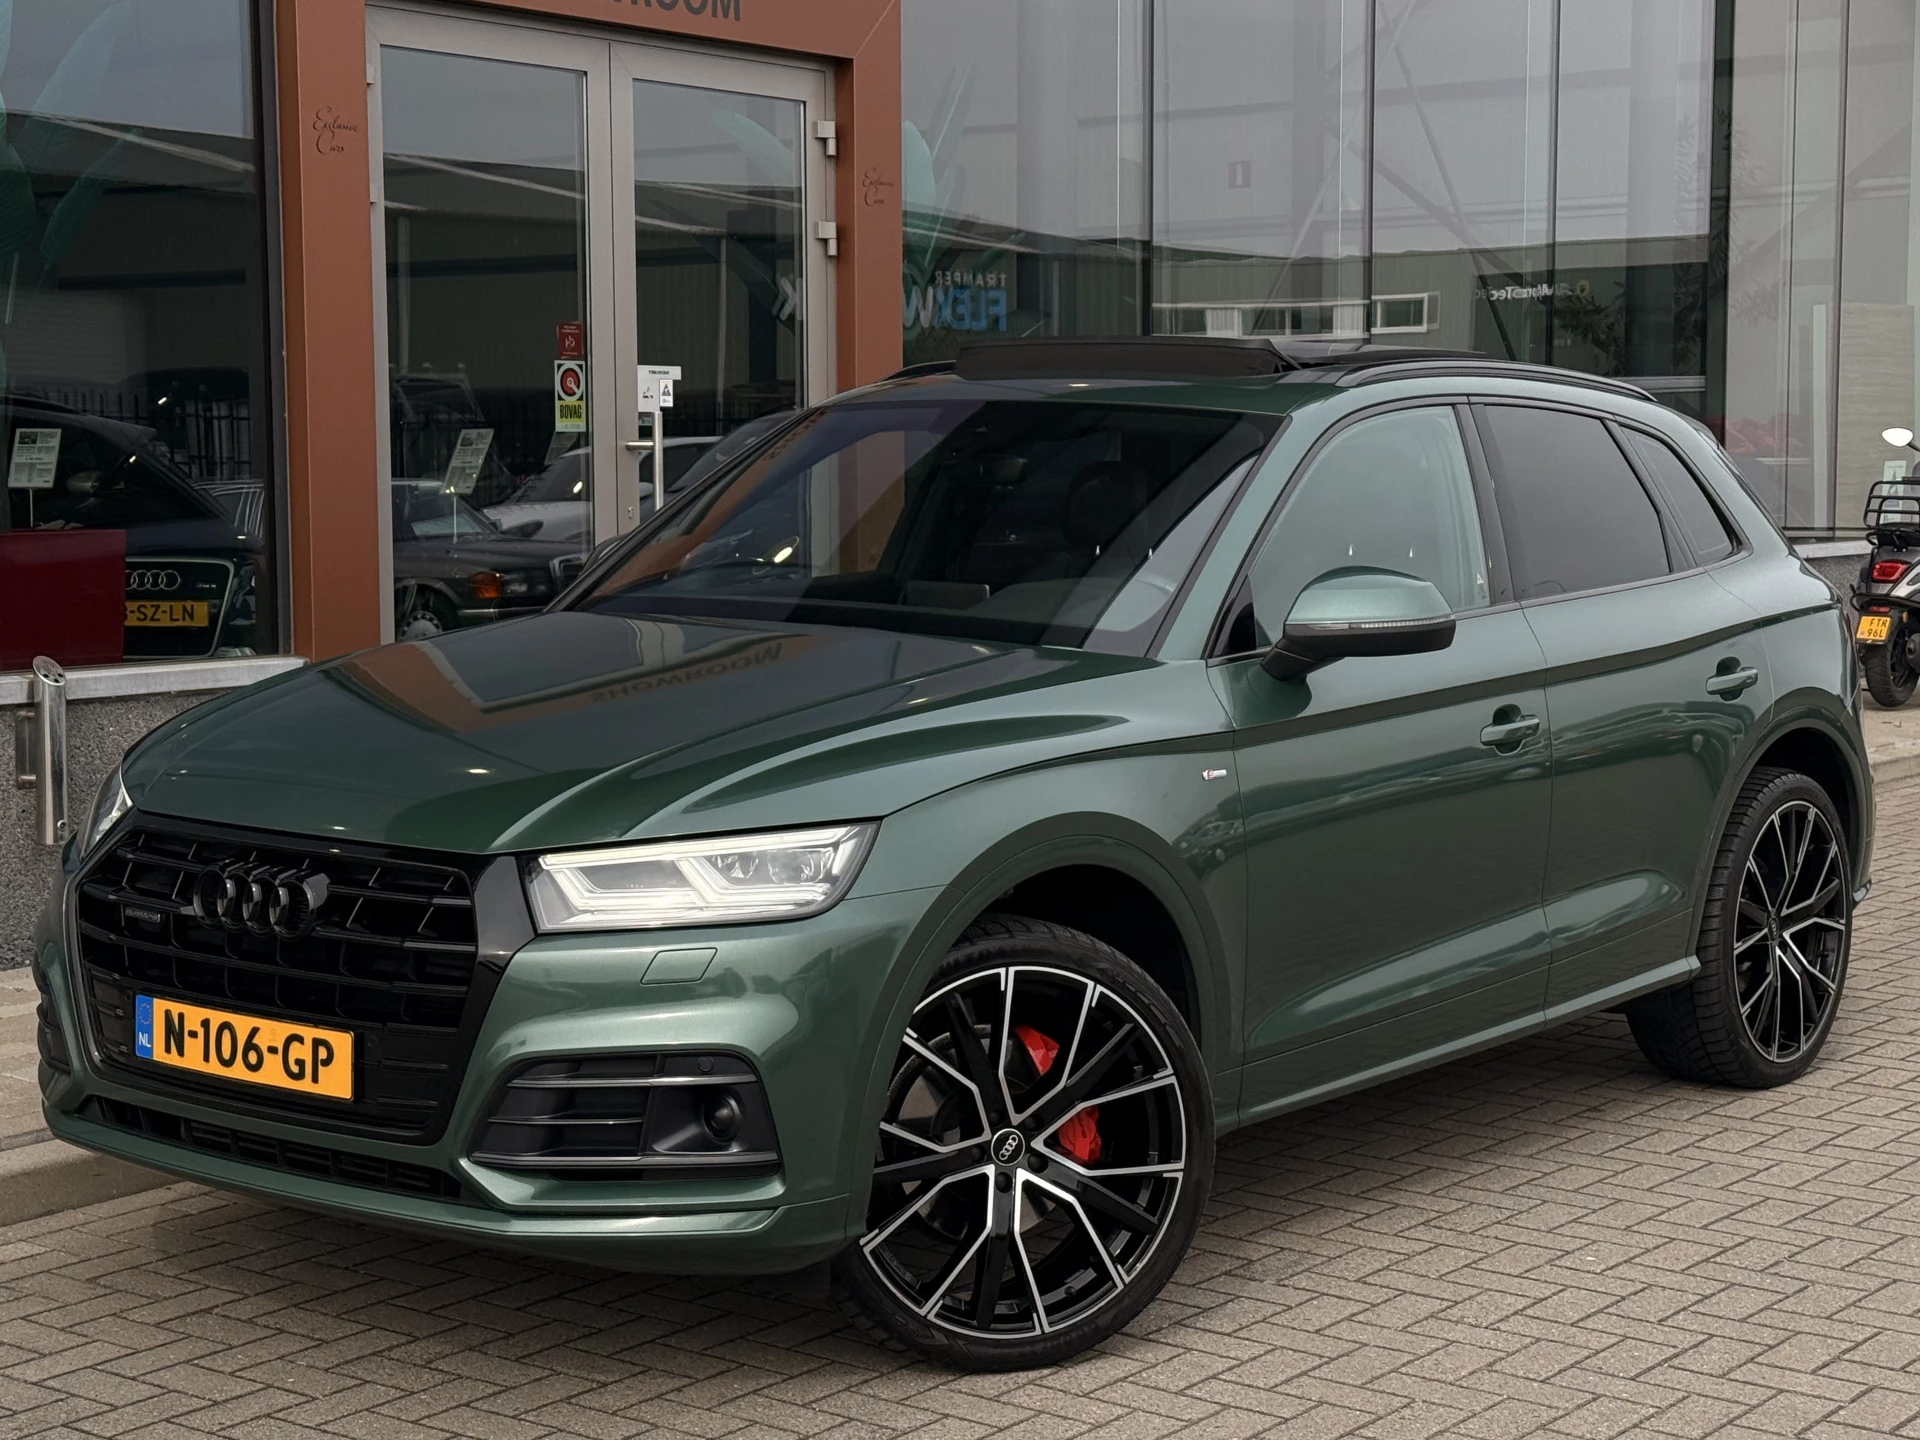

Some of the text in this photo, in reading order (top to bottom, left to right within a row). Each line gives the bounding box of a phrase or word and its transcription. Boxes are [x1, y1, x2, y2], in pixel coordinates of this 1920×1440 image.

[559, 404, 582, 420] BOVAG
[125, 603, 194, 622] -SZ-LN
[1869, 618, 1888, 628] FTR
[1867, 628, 1884, 638] 96L
[138, 1031, 152, 1048] NL
[164, 1008, 335, 1085] N-106-GP
